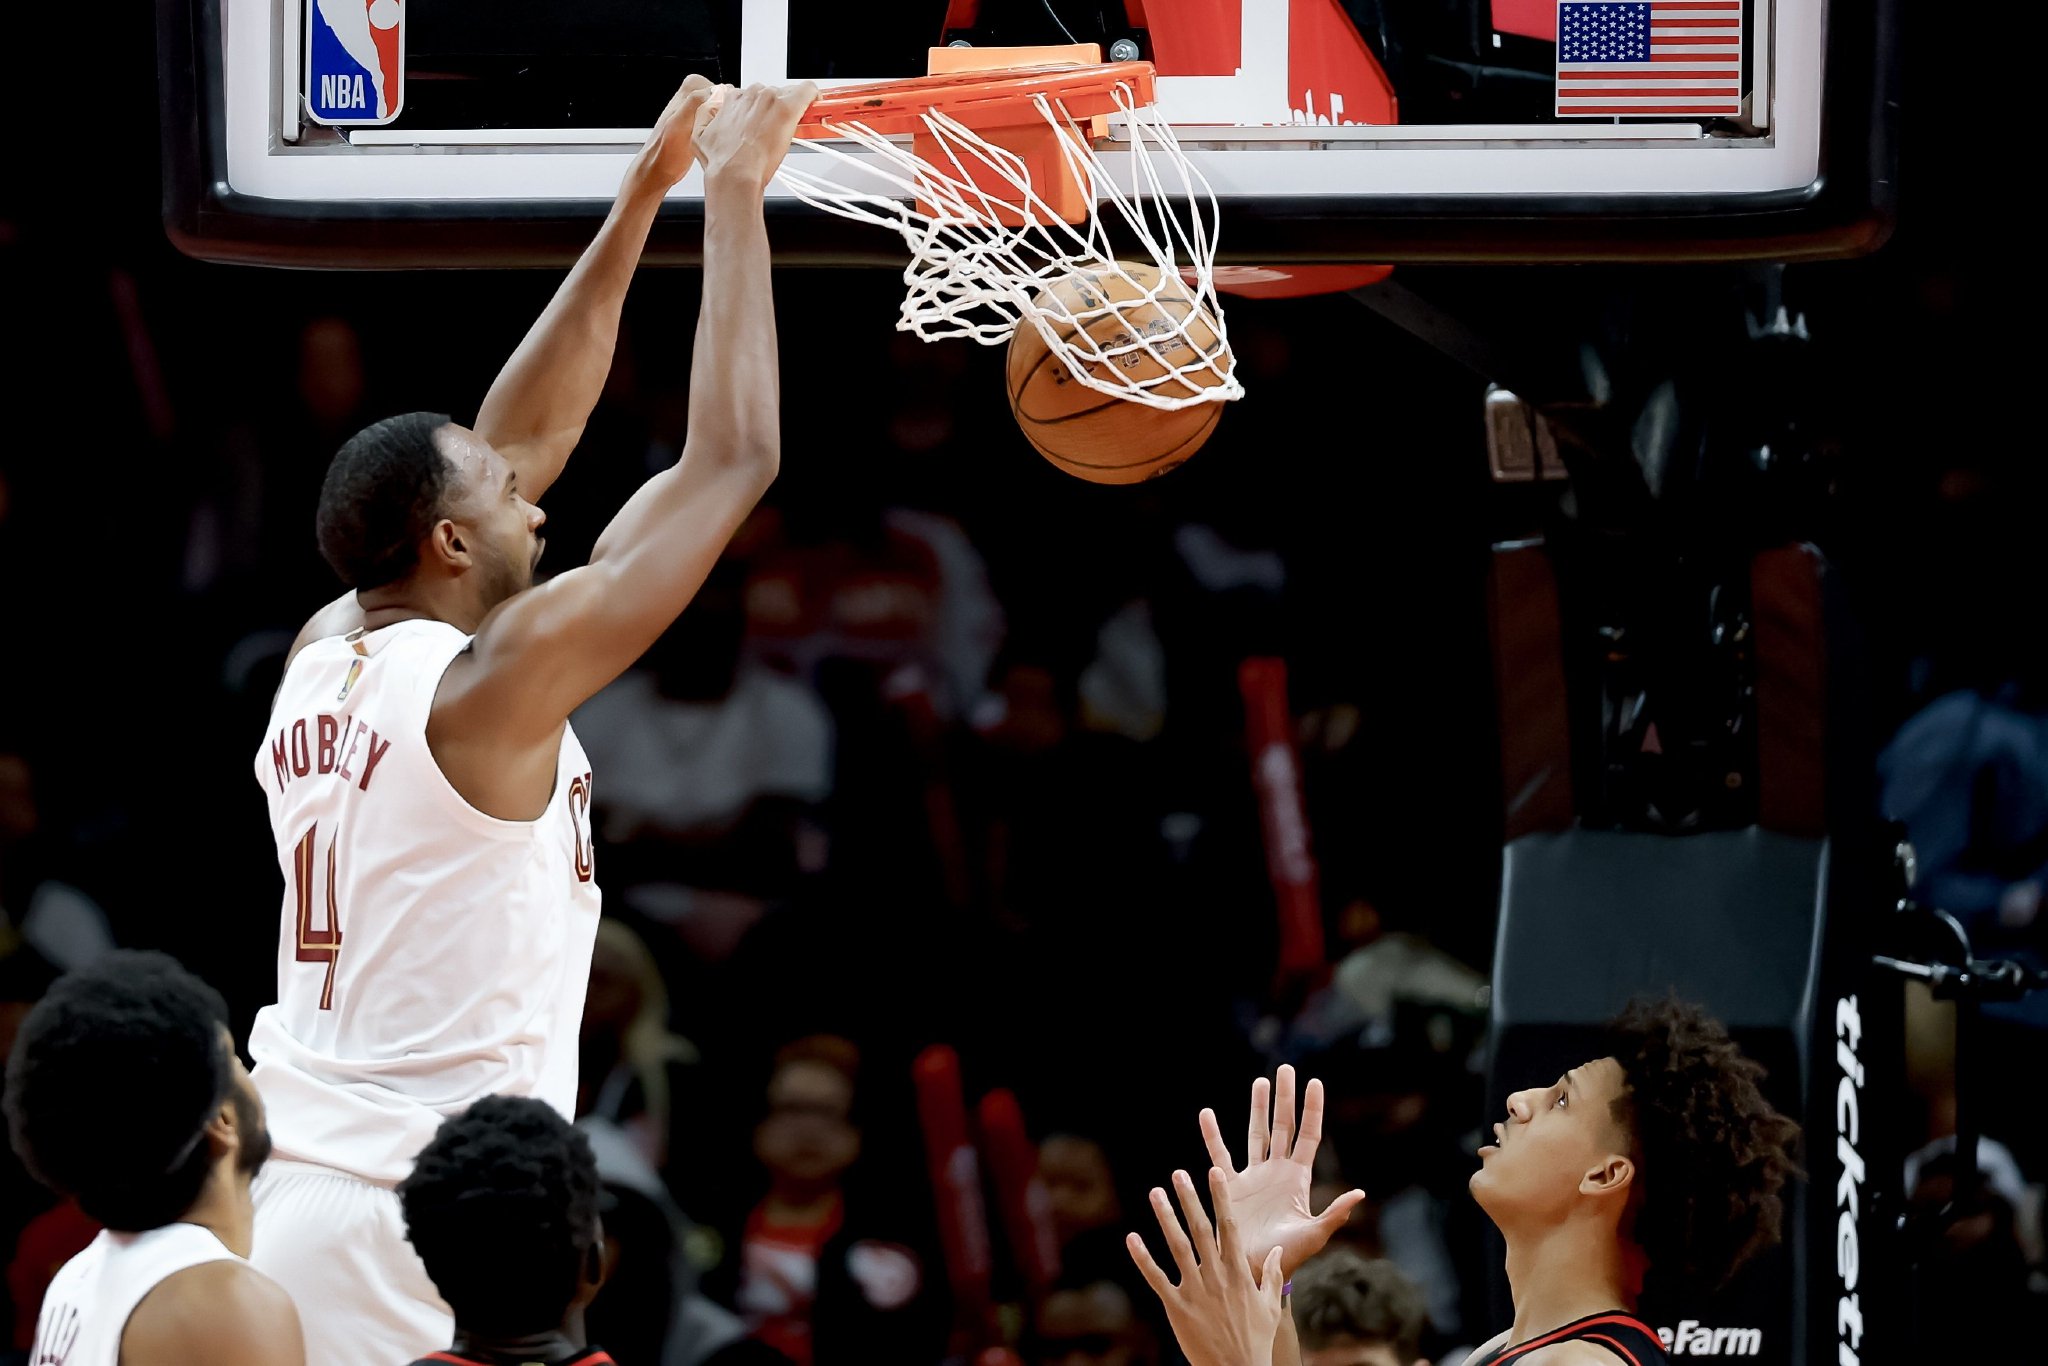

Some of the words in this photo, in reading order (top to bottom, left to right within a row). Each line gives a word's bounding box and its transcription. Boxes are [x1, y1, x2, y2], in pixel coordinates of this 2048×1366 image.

[321, 74, 366, 109] NBA
[294, 820, 343, 1011] 4
[1836, 994, 1865, 1366] ticket
